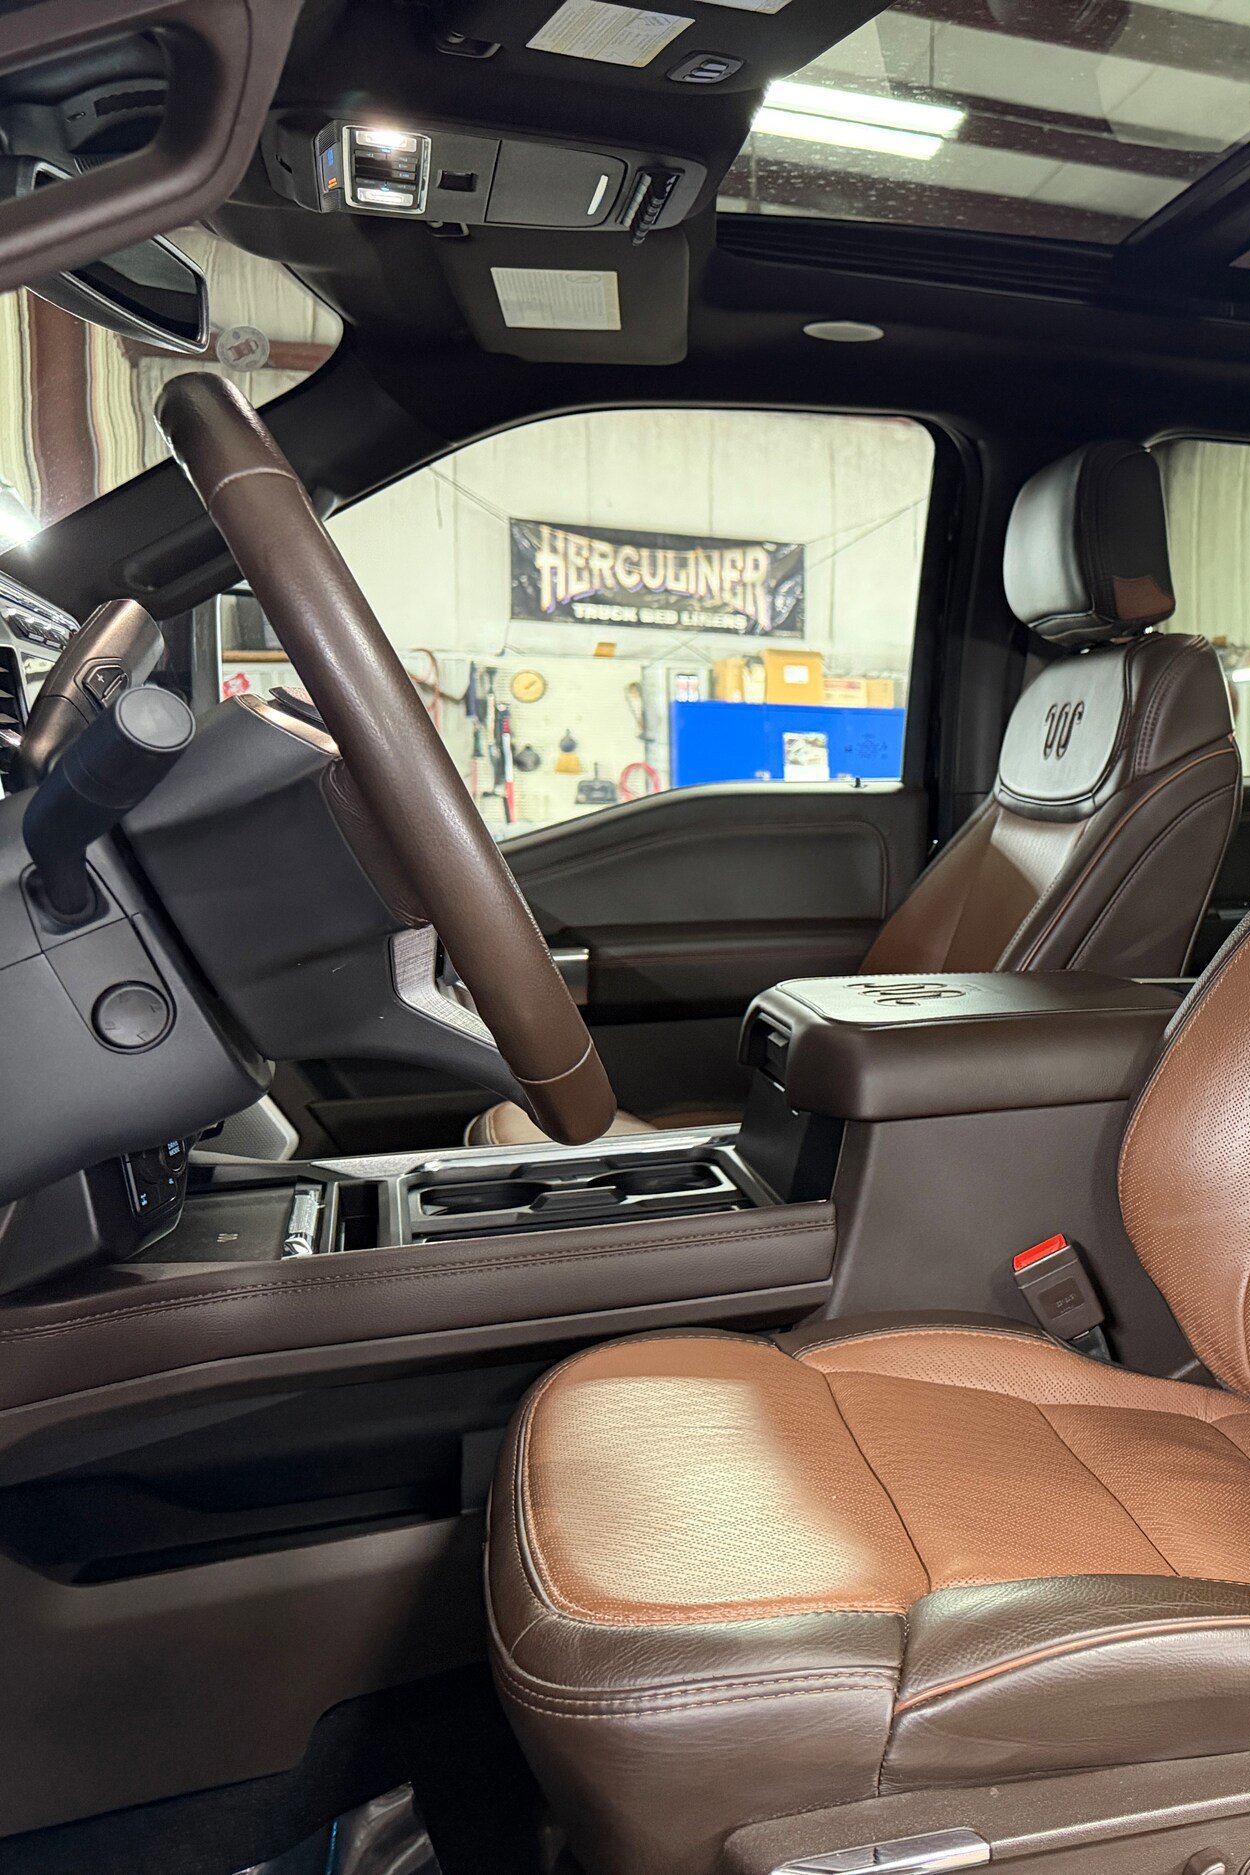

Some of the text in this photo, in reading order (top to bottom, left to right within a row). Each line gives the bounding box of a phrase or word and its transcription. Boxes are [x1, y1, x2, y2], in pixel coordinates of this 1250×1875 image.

[535, 525, 772, 632] HERCULINER
[571, 602, 748, 630] TRUCK BED LINERS
